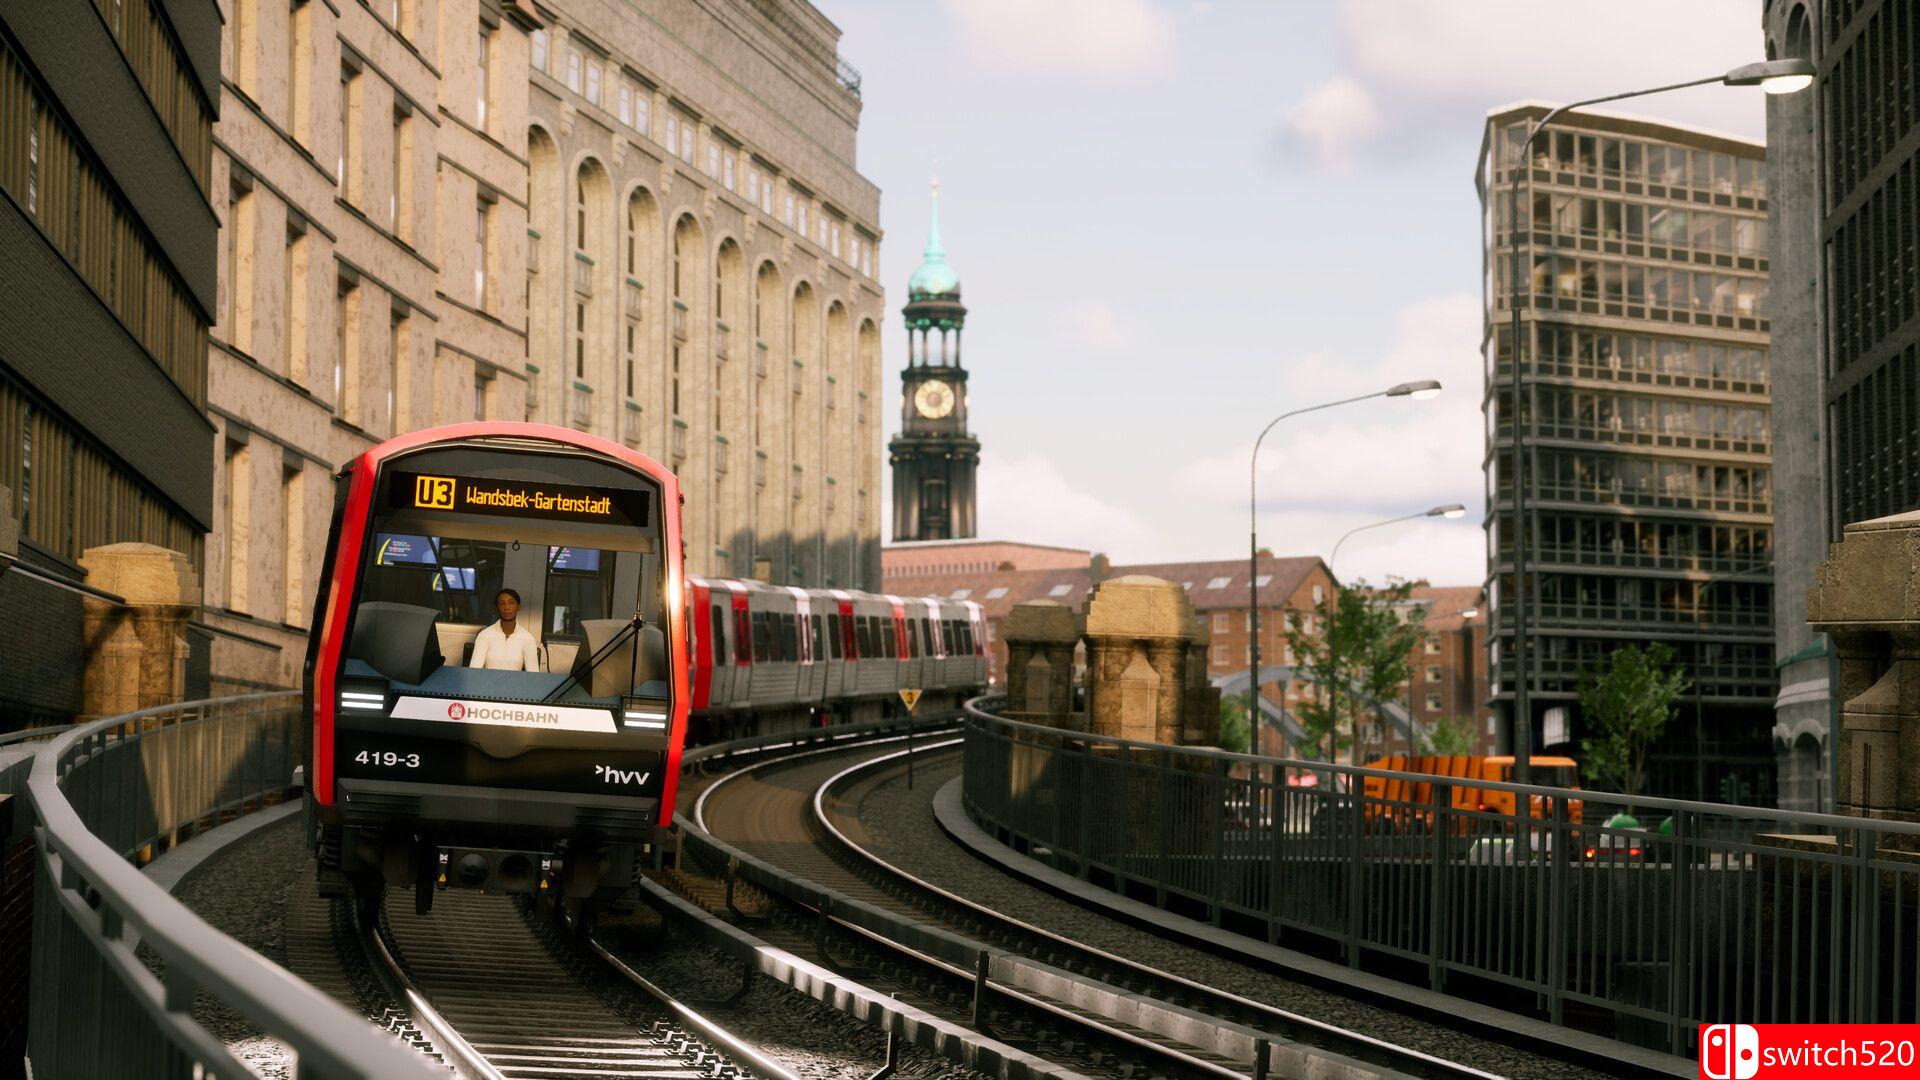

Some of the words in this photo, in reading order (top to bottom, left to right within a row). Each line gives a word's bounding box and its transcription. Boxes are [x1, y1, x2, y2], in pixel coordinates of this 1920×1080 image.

[417, 478, 454, 507] U3
[466, 486, 612, 515] Wandsbek-Gartenstadt
[906, 692, 914, 704] 3
[467, 707, 560, 724] HOCHBAHN
[355, 750, 421, 768] 419-3
